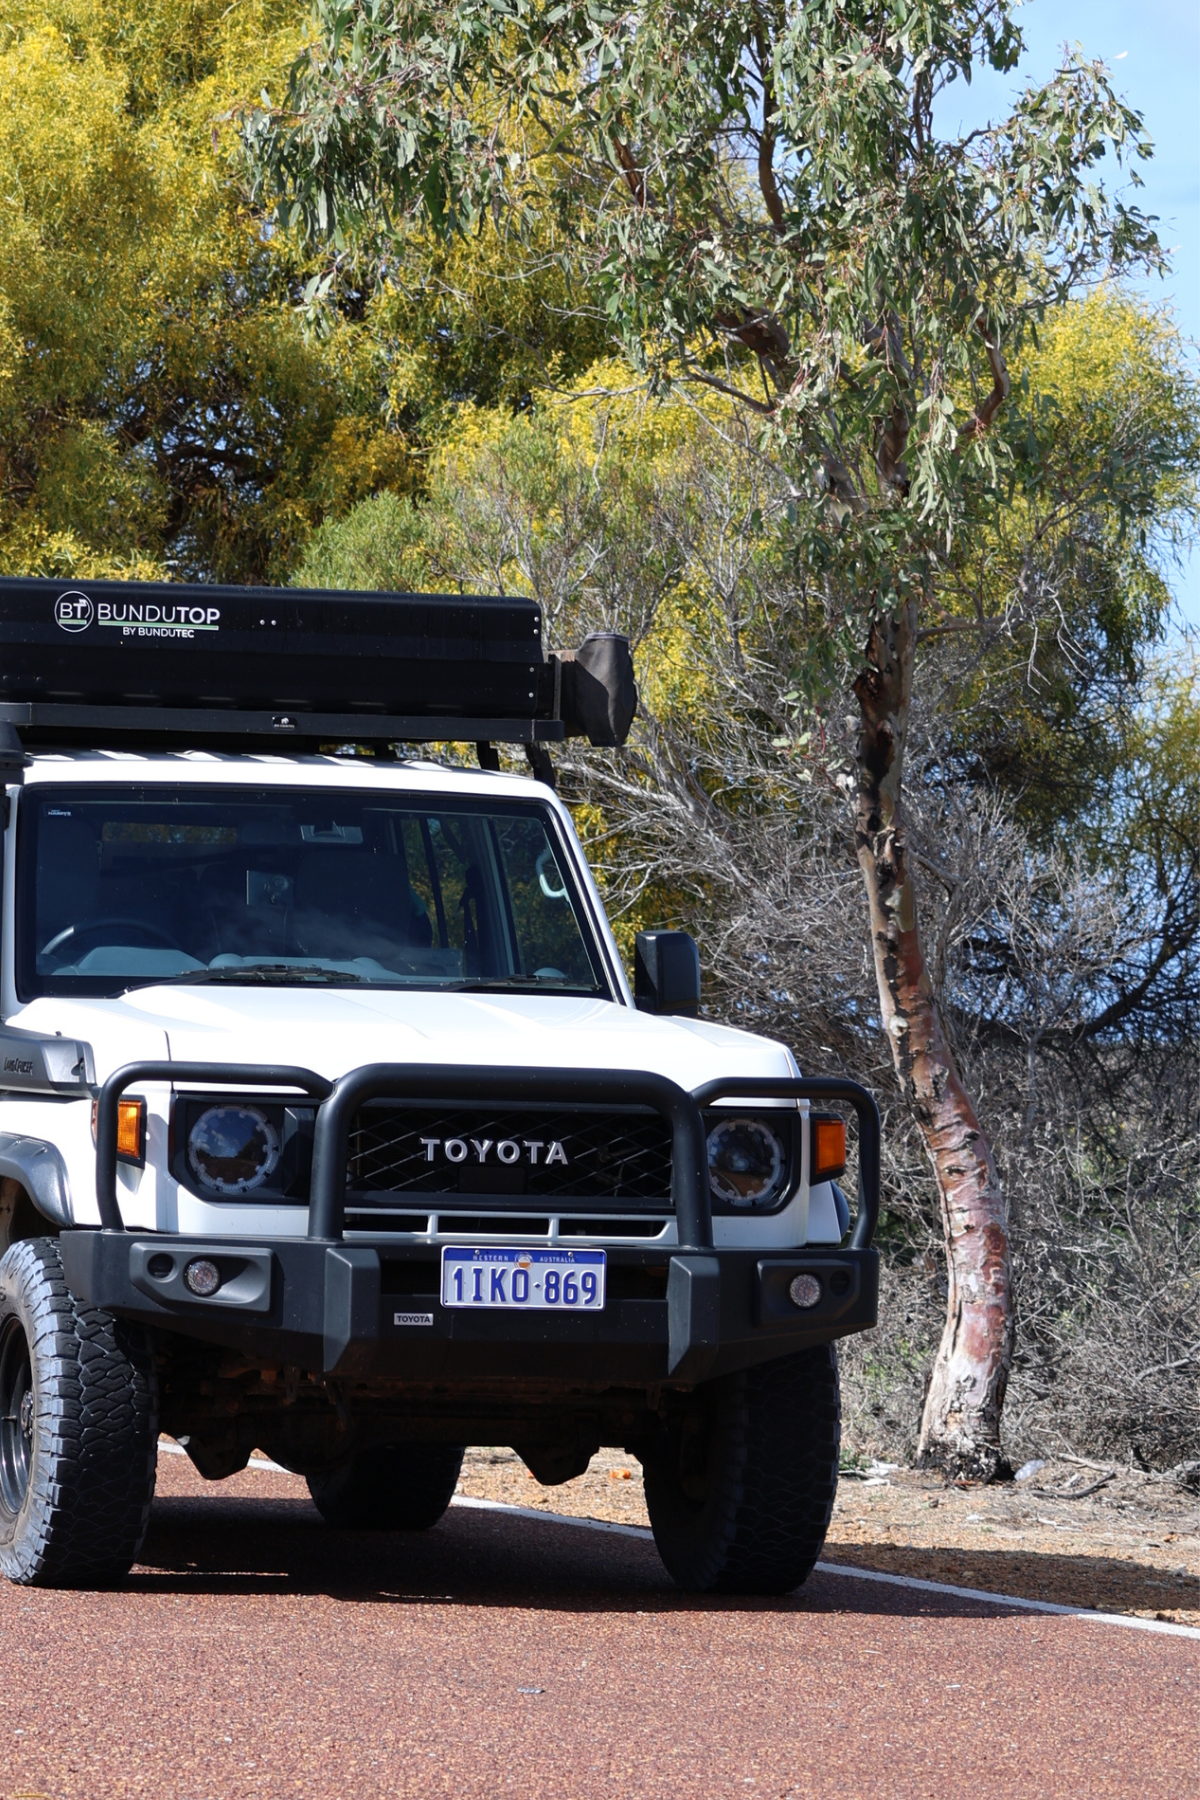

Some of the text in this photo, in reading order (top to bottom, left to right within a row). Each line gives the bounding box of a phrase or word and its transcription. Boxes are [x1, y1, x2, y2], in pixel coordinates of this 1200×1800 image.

[97, 603, 221, 625] BUNDUTOP
[122, 627, 195, 638] BY BUNDUTEC
[419, 1137, 569, 1165] TOYOTA
[472, 1254, 509, 1262] WESTERN
[396, 1315, 431, 1323] TOYOTA
